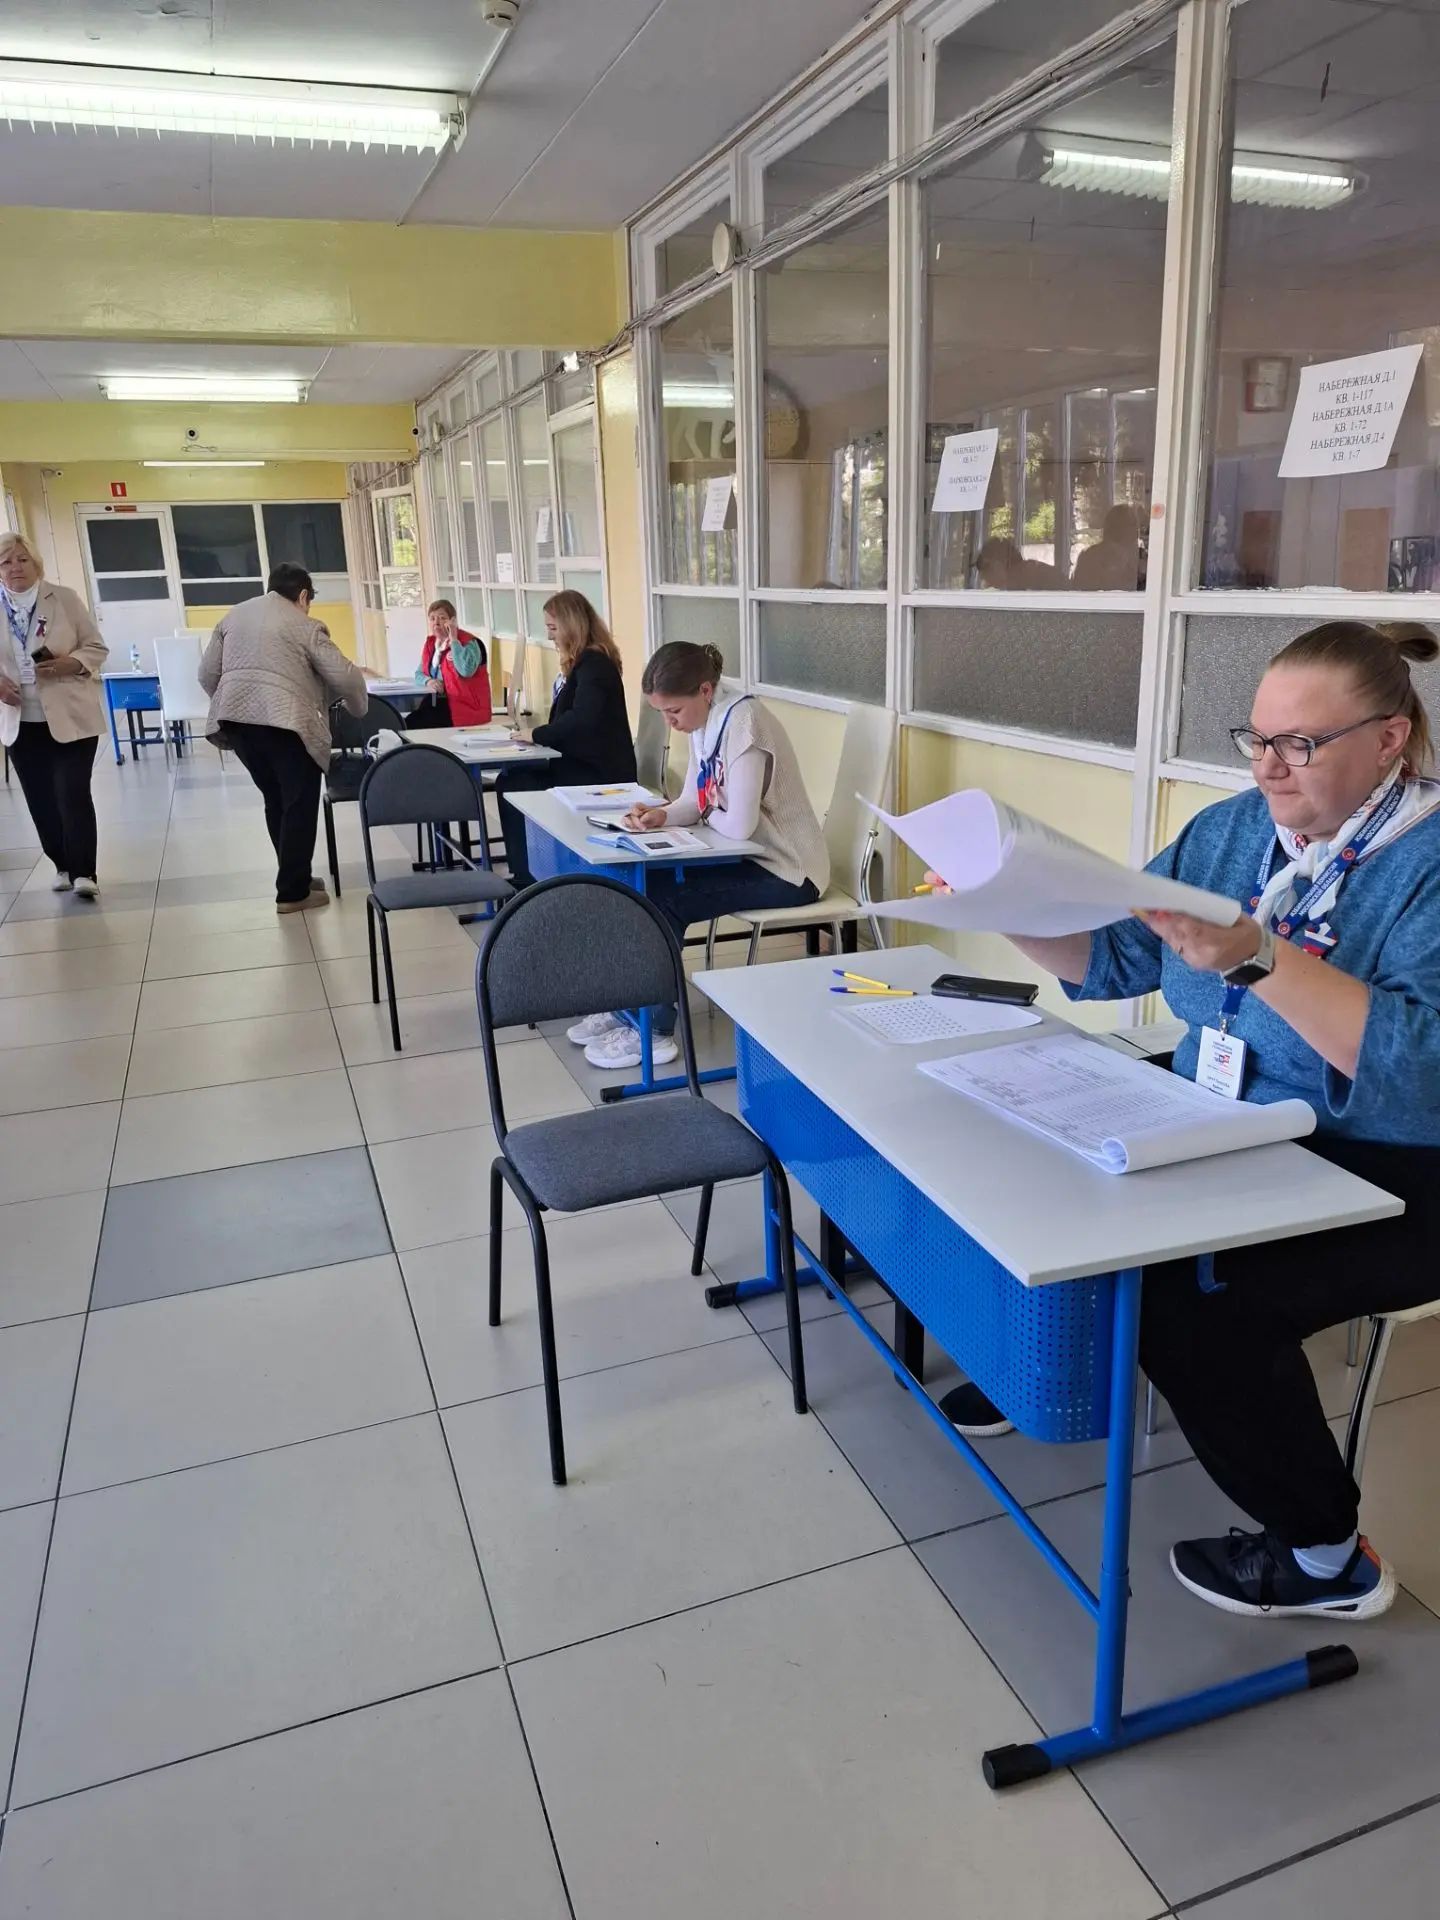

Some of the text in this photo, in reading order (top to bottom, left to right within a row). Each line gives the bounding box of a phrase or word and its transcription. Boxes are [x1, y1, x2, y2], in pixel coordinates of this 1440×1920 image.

[1318, 372, 1381, 392] НАБЕРЕЖНАЯ
[1352, 388, 1374, 401] 1-117
[1312, 403, 1373, 422] НАБЕРЕЖНАЯ
[1350, 419, 1367, 431] 1-72
[1310, 433, 1371, 450] НАБЕРЕЖНАЯ
